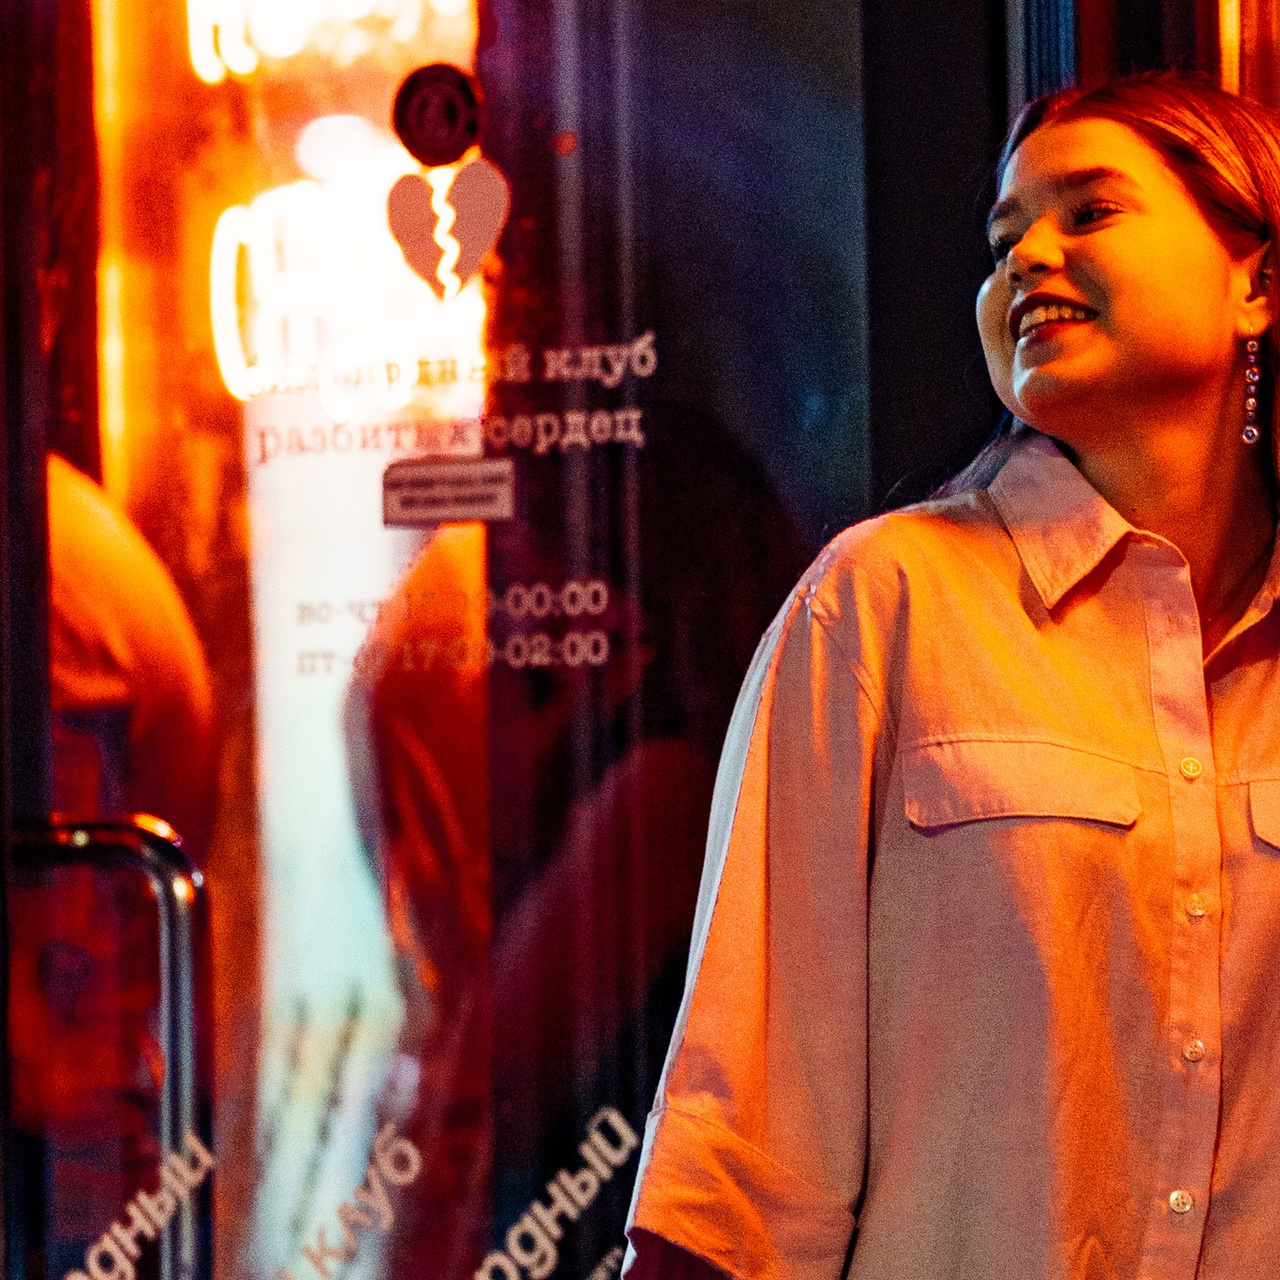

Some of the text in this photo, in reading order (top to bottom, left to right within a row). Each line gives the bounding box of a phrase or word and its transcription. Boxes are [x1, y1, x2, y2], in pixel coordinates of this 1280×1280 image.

[544, 330, 659, 388] клуб
[256, 407, 646, 467] разбитых сердец
[302, 1121, 422, 1280] клуб
